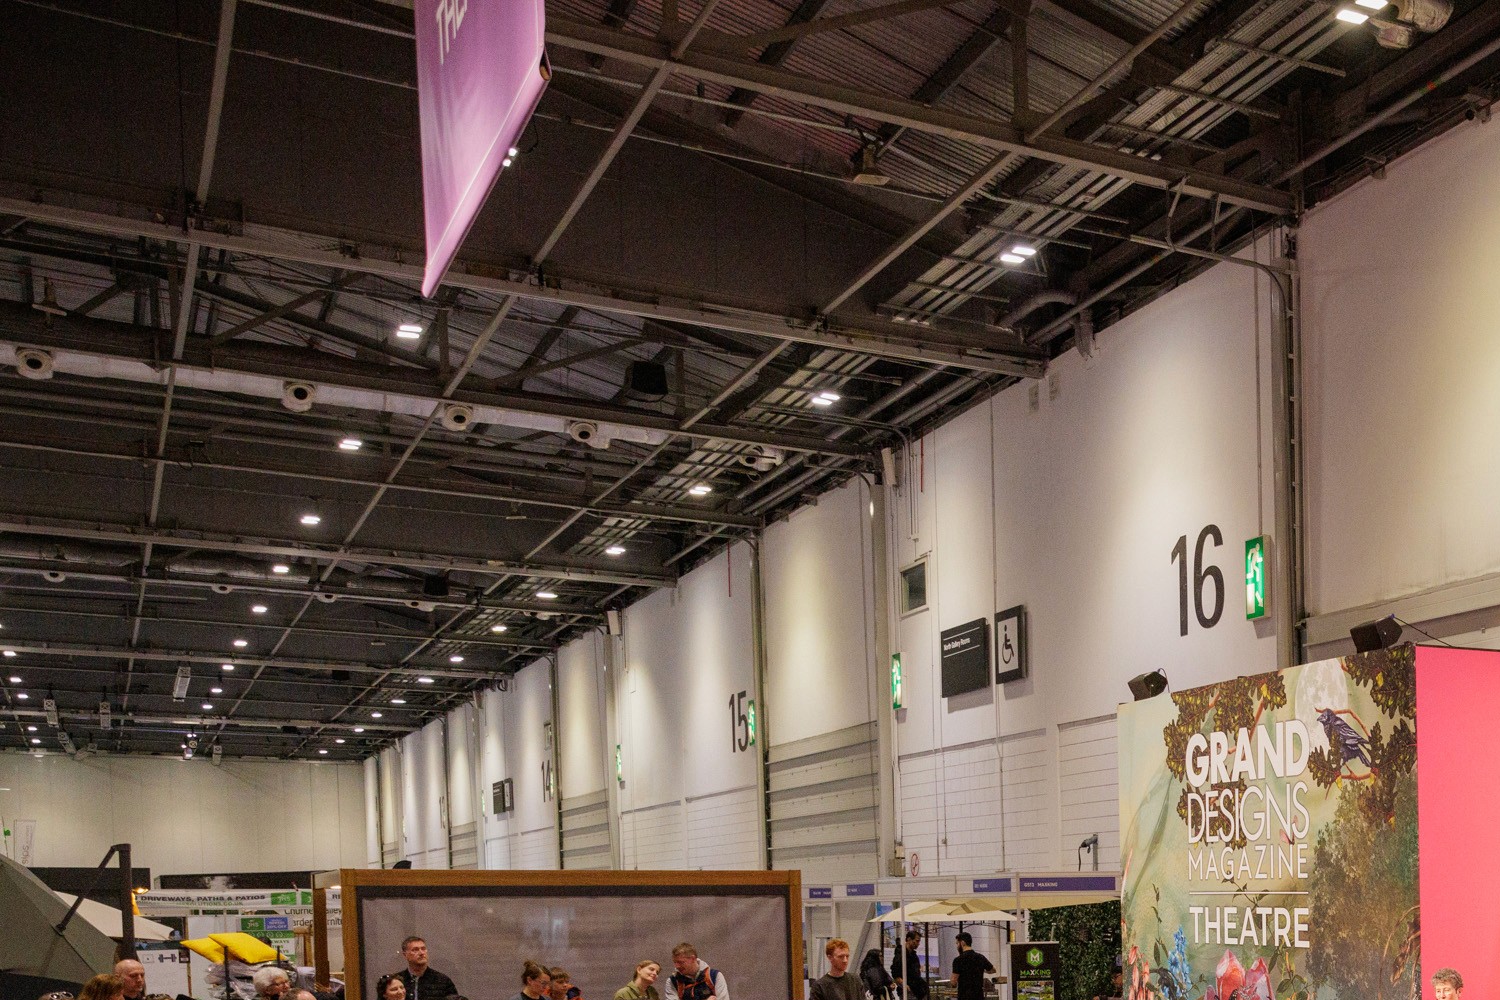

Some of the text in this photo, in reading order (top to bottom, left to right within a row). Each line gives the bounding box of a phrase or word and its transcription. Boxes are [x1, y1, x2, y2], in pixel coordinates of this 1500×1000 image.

[1170, 523, 1225, 637] 16
[728, 690, 749, 753] 15
[1185, 718, 1310, 788] GRAND
[541, 759, 551, 803] 14
[1187, 780, 1311, 844] DESIGNS
[1188, 844, 1309, 881] MAGAZINE
[1189, 906, 1311, 949] THEATRE
